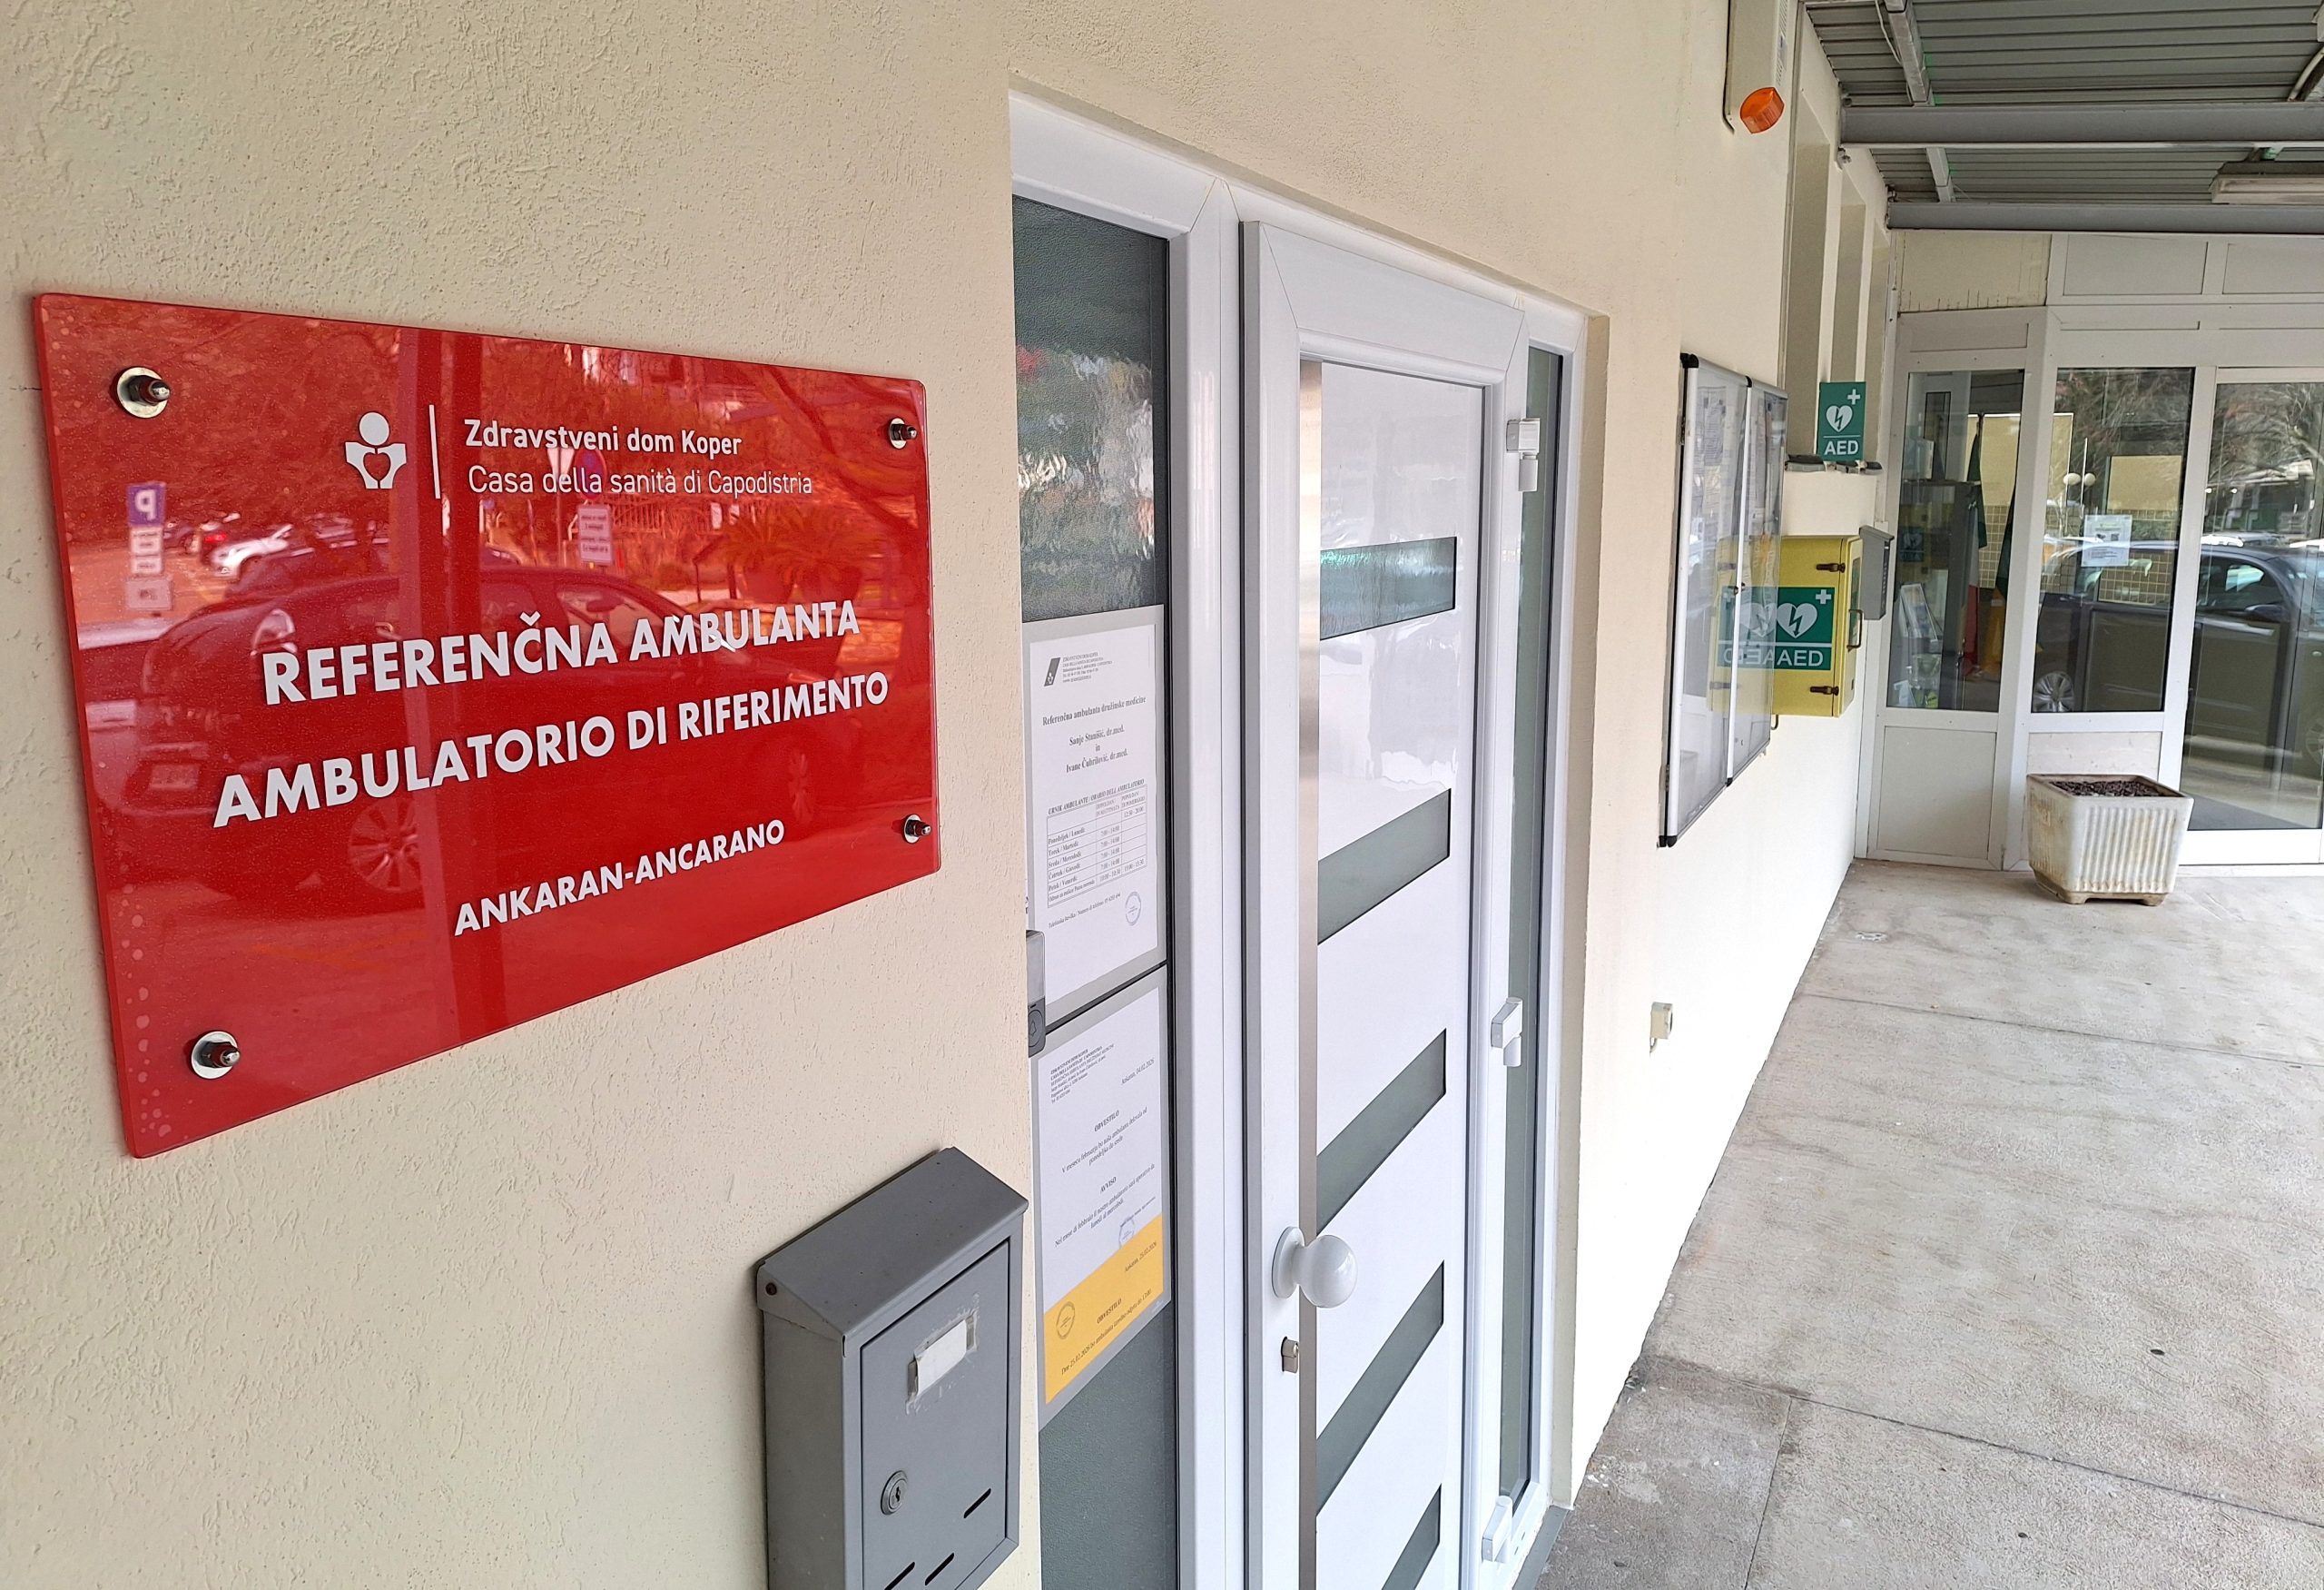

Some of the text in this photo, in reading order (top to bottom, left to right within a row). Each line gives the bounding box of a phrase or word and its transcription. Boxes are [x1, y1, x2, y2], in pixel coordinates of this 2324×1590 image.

[465, 419, 742, 460] Zdravstveni dom Koper
[1824, 440, 1858, 455] AED
[468, 453, 812, 499] Casa della sanità di Capodistria
[262, 598, 861, 706] REFERENČNA AMBULANTA
[1777, 649, 1824, 667] AED
[1073, 707, 1100, 719] ambulanta
[1125, 696, 1147, 708] medicine
[213, 671, 888, 828] AMBULATORIO DI RIFERIMENTO
[1095, 744, 1100, 752] in
[454, 819, 784, 936] ANKARAN-ANCARANO
